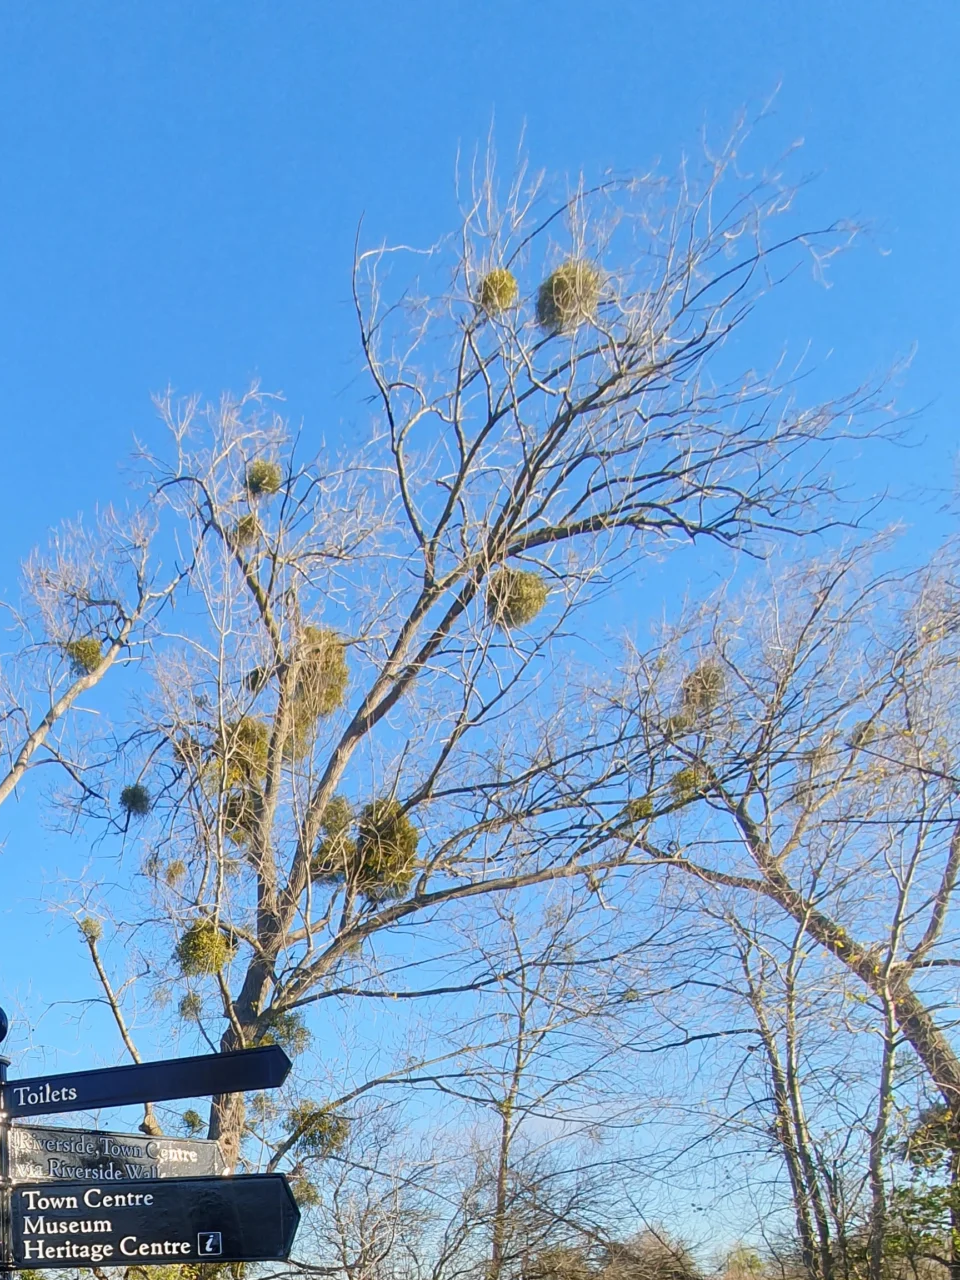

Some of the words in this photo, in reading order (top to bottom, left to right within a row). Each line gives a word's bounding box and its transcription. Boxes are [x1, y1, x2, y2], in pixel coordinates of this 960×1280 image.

[14, 1083, 78, 1106] Toilets
[19, 1132, 99, 1156] Riverside,
[100, 1137, 142, 1157] Town
[146, 1141, 198, 1162] Centre
[16, 1160, 43, 1177] via
[48, 1159, 123, 1179] Riverside
[22, 1191, 78, 1210] Town
[83, 1188, 154, 1208] Centre
[22, 1216, 112, 1235] Museum
[23, 1239, 114, 1262] Heritage
[119, 1236, 191, 1256] Centre
